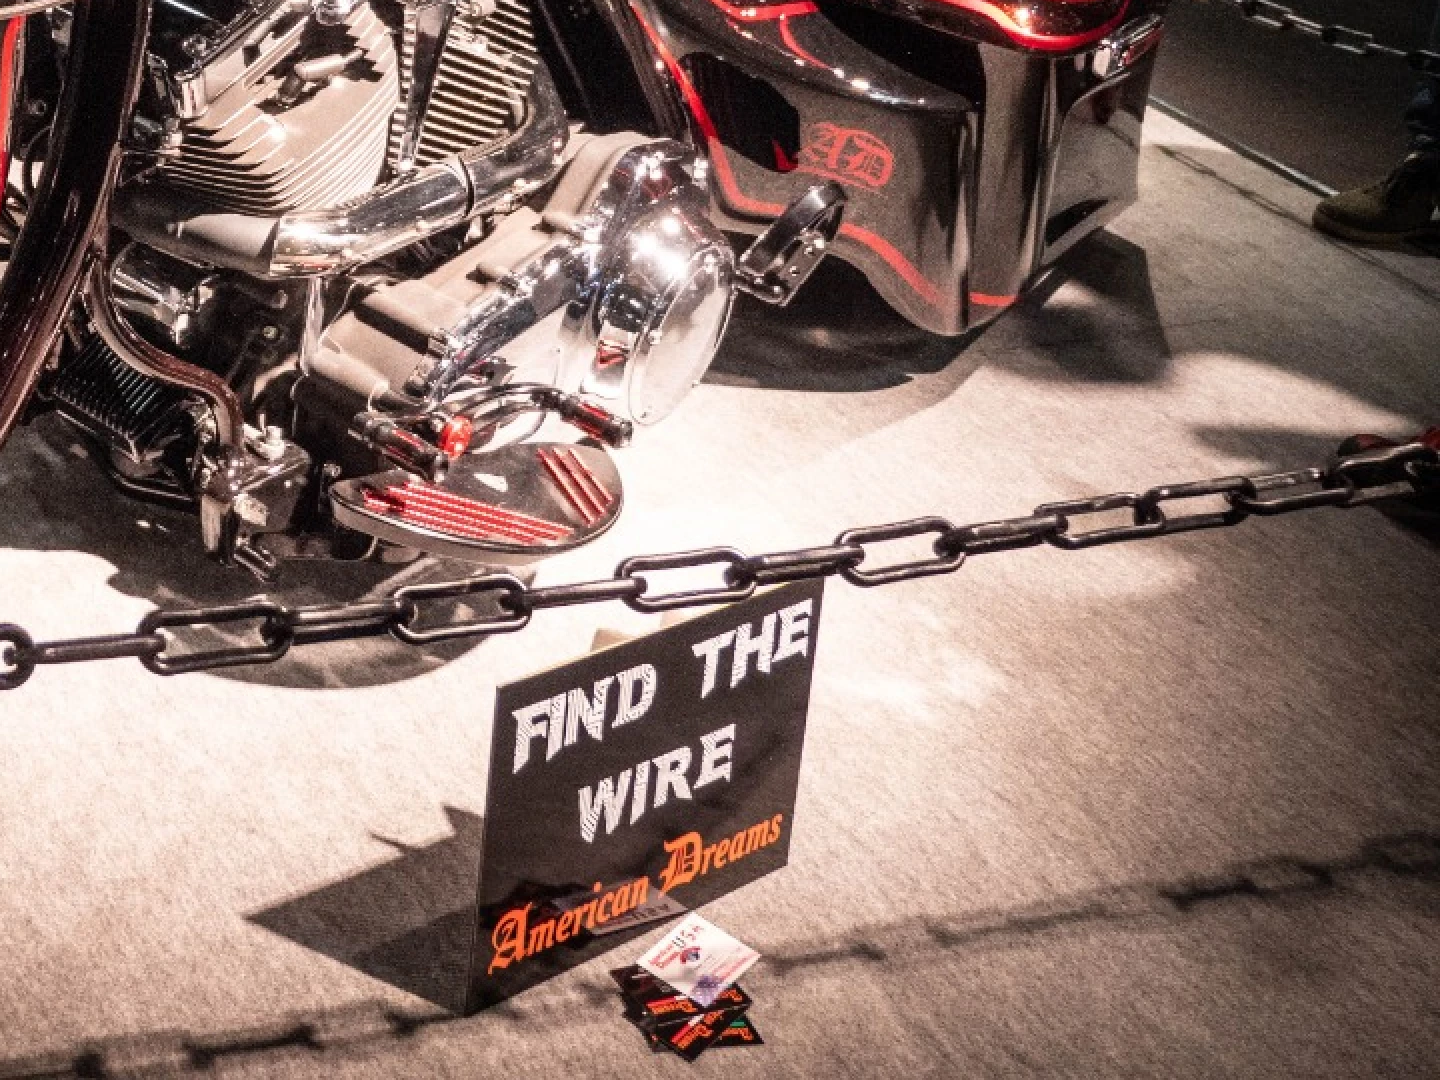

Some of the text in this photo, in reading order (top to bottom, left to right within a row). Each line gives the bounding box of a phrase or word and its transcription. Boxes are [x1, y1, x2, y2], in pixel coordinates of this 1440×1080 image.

[512, 598, 813, 774] FIND THE
[577, 723, 735, 843] WIRE
[487, 881, 648, 975] American
[658, 813, 782, 898] Dreams
